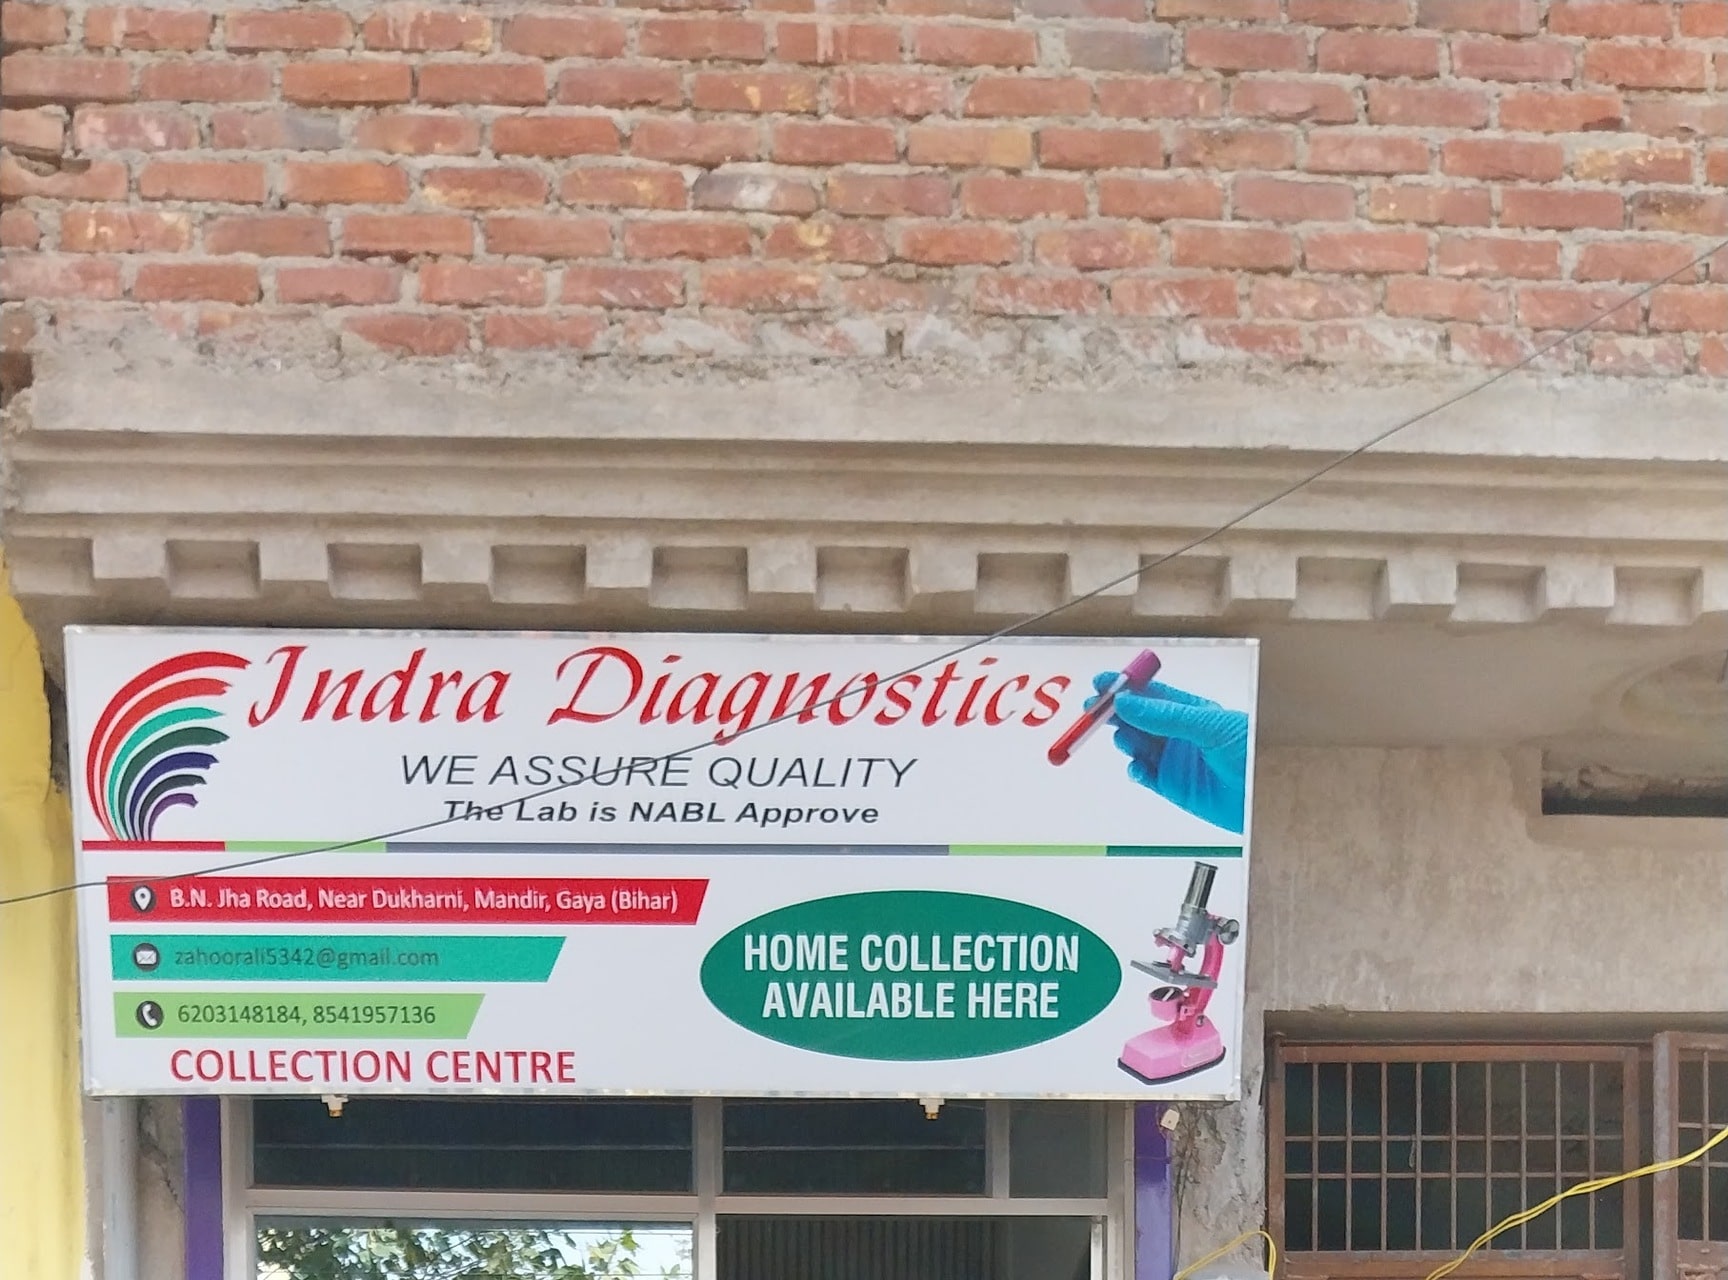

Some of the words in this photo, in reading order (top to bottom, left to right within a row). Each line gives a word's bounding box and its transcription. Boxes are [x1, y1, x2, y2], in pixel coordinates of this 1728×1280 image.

[248, 645, 512, 728] Indra
[547, 645, 1073, 746] Diagnostics
[401, 754, 478, 785] WE
[489, 754, 692, 786] ASSURE
[708, 756, 918, 790] QUALITY
[444, 801, 503, 821] The
[516, 801, 577, 822] Lab
[589, 801, 616, 822] is
[629, 801, 726, 823] NABL
[736, 802, 879, 828] Approve
[170, 888, 212, 908] B.N.
[217, 886, 251, 908] Jha
[256, 886, 314, 911] Road,
[319, 888, 367, 909] Near
[372, 887, 469, 912] Dukharni,
[474, 888, 551, 912] Mandir,
[557, 890, 606, 913] Gaya
[612, 887, 678, 914] (Bihar)
[175, 948, 439, 969] zahoorali5342@gmail.com
[744, 933, 848, 972] HOME
[860, 933, 1078, 973] COLLECTION
[178, 1005, 307, 1026] 6203148184,
[313, 1005, 436, 1024] 8541957136
[762, 982, 955, 1019] AVAILABLE
[968, 982, 1059, 1019] HERE
[171, 1049, 412, 1083] COLLECTION
[425, 1050, 576, 1083] CENTRE
